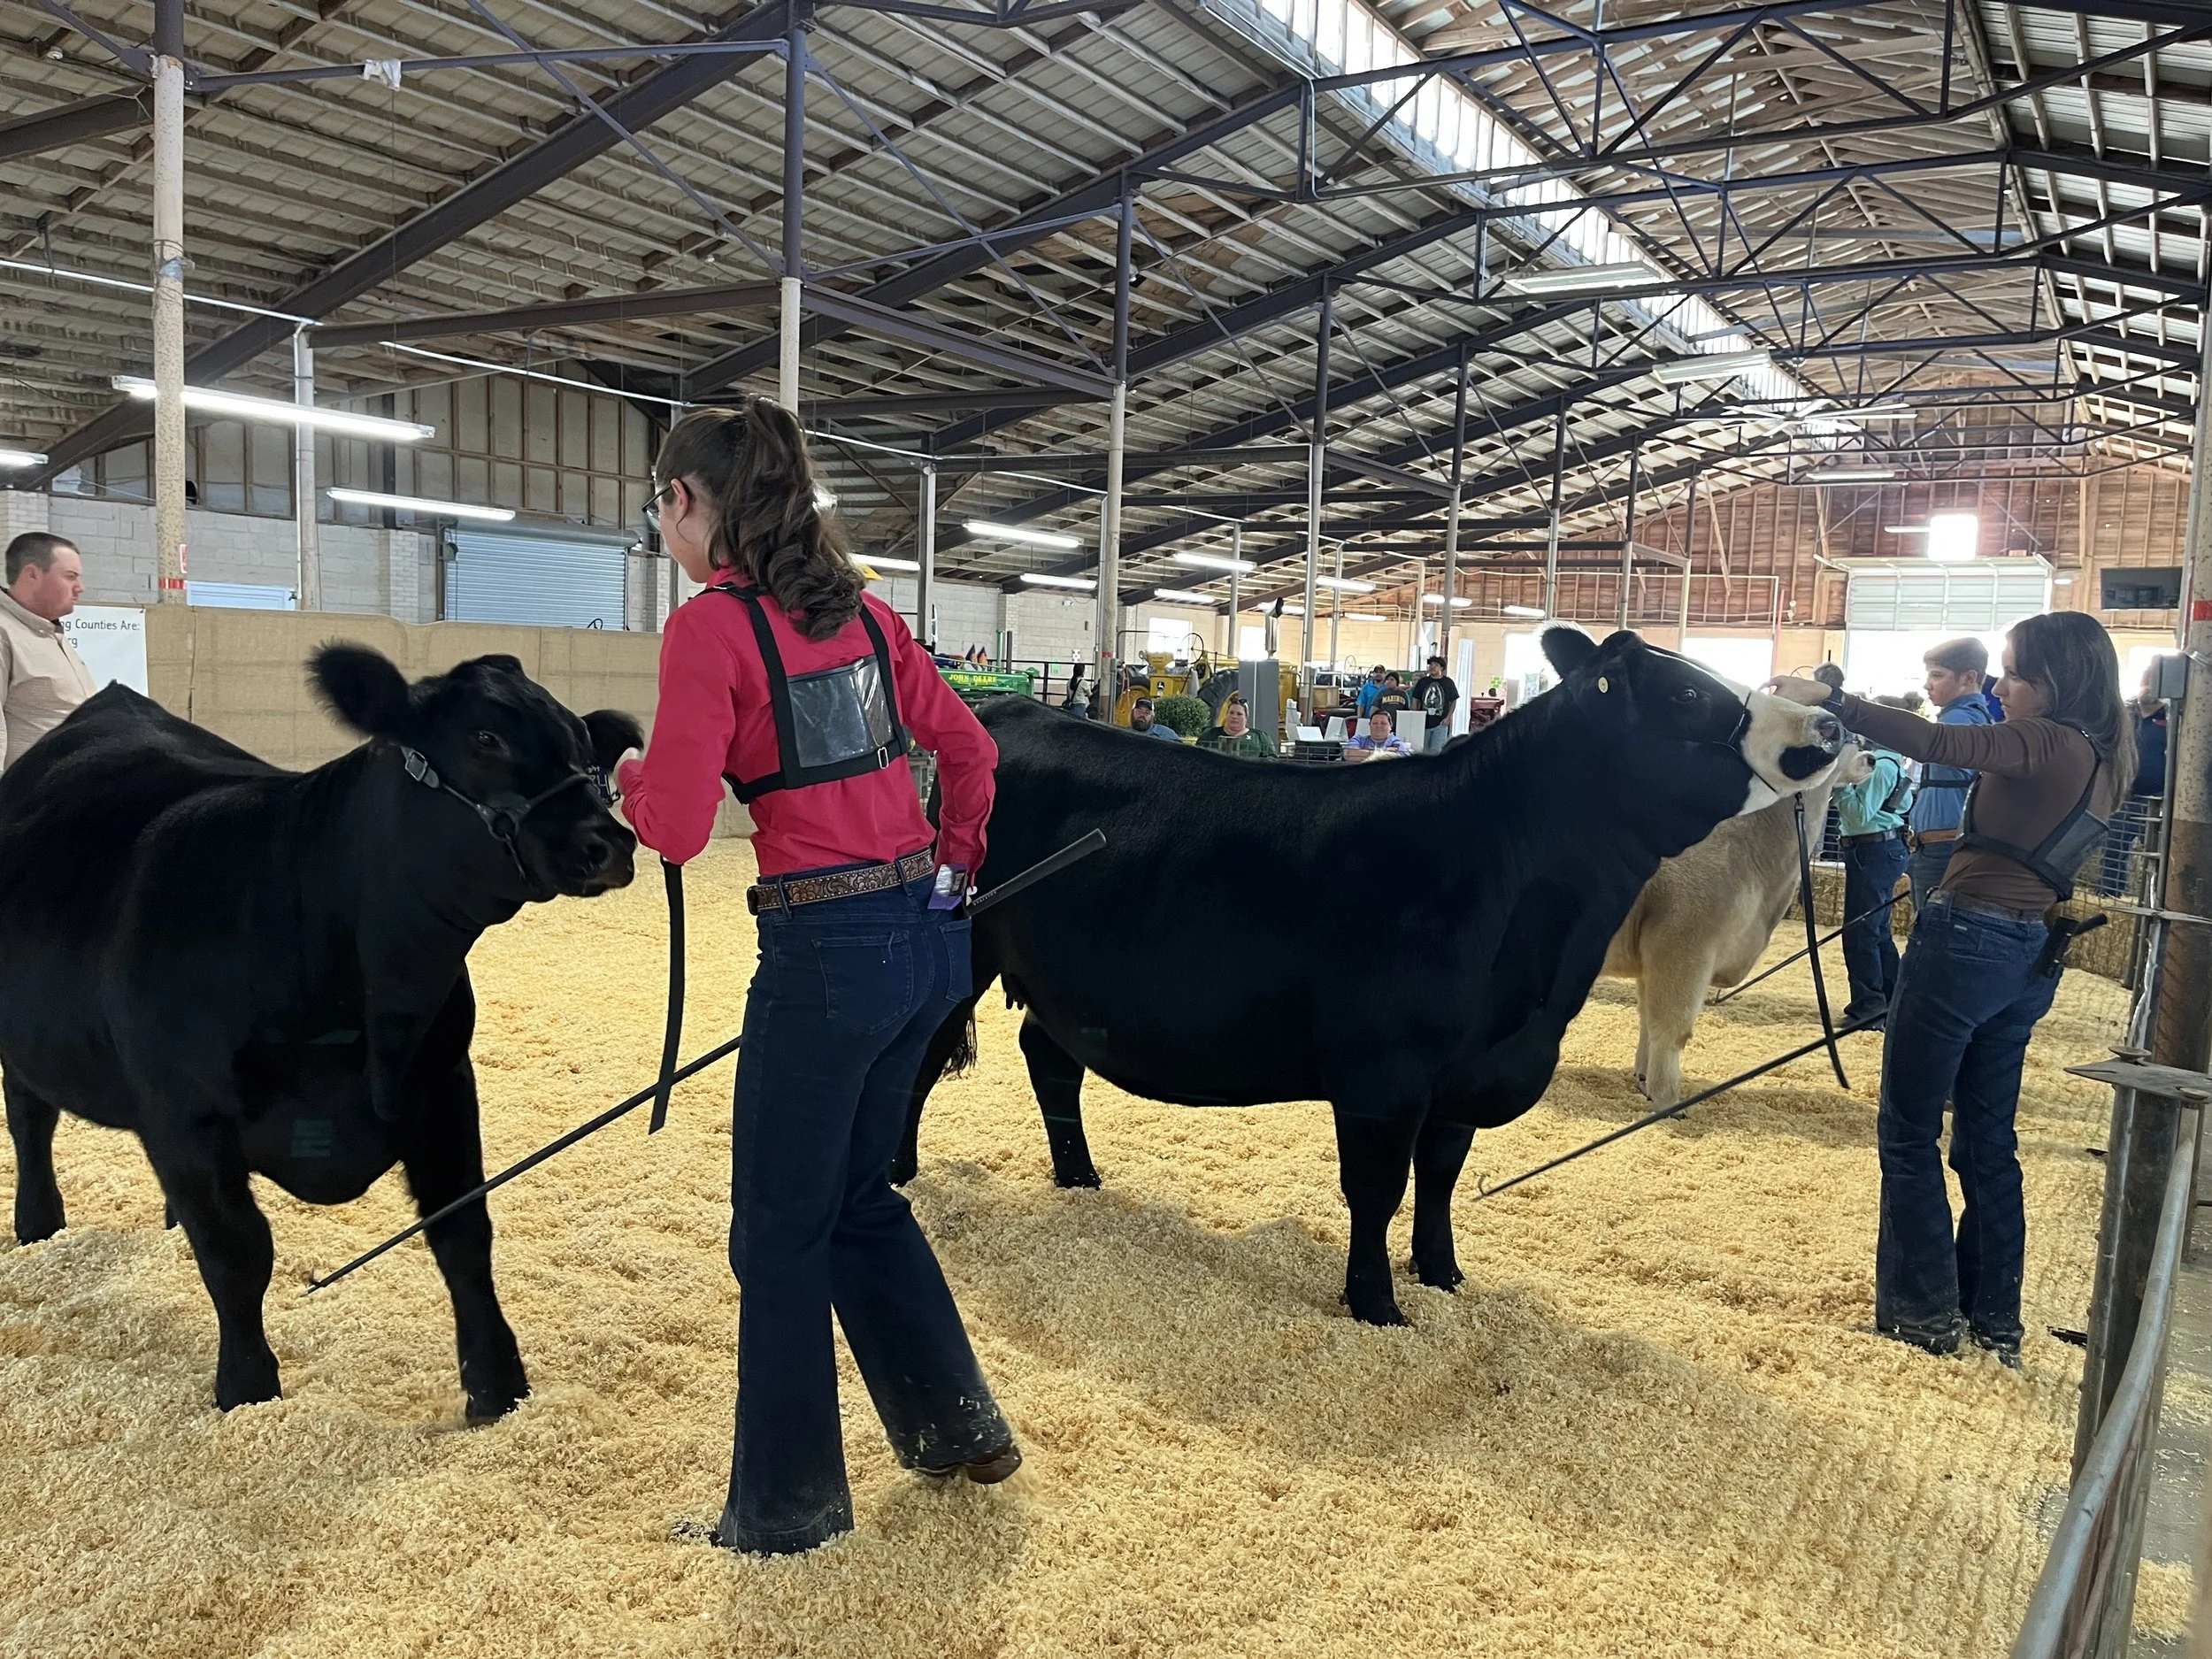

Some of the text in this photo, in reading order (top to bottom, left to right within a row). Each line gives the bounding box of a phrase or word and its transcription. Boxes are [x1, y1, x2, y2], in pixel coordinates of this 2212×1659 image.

[75, 618, 117, 630] Counties
[949, 673, 997, 684] JOHN DEERE
